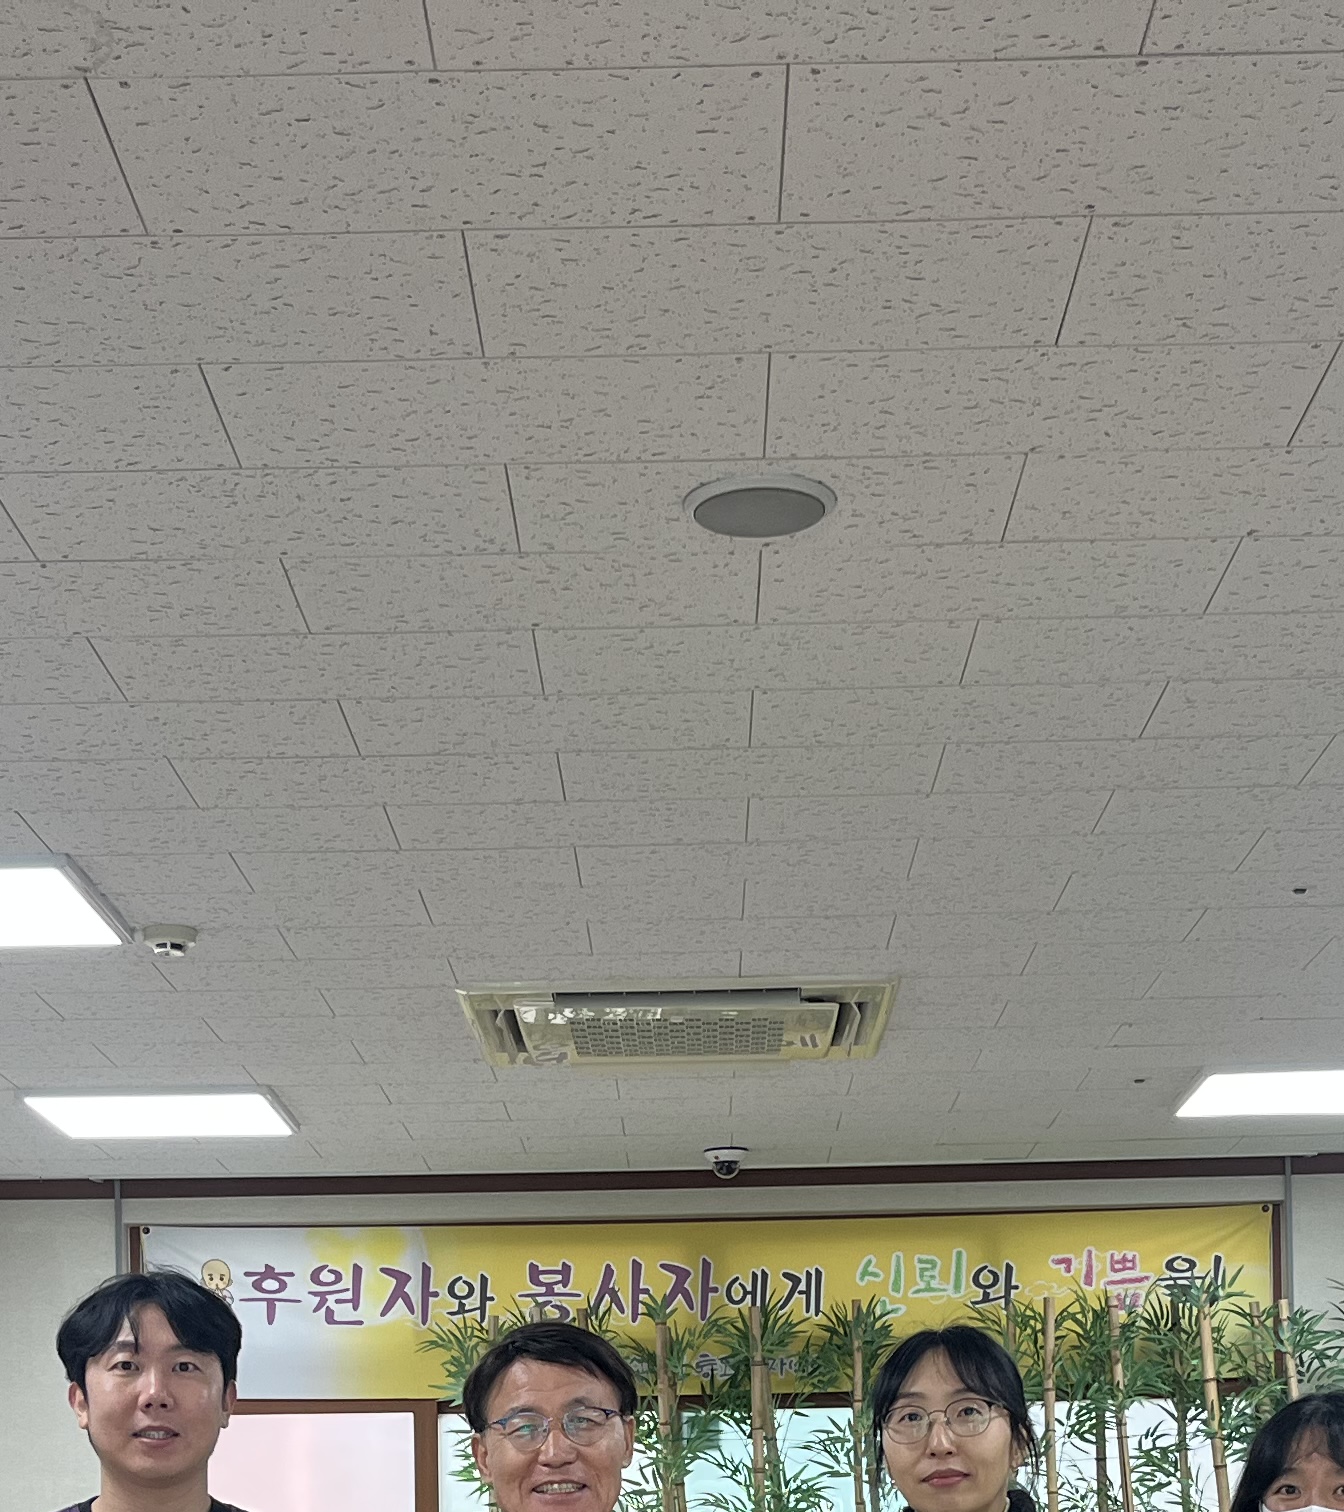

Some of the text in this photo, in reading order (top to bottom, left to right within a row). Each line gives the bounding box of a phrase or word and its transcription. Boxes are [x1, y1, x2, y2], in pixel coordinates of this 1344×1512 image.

[239, 1258, 495, 1326] 후원자와
[519, 1256, 823, 1325] 봉사자에게
[858, 1250, 1021, 1315] 신뢰와
